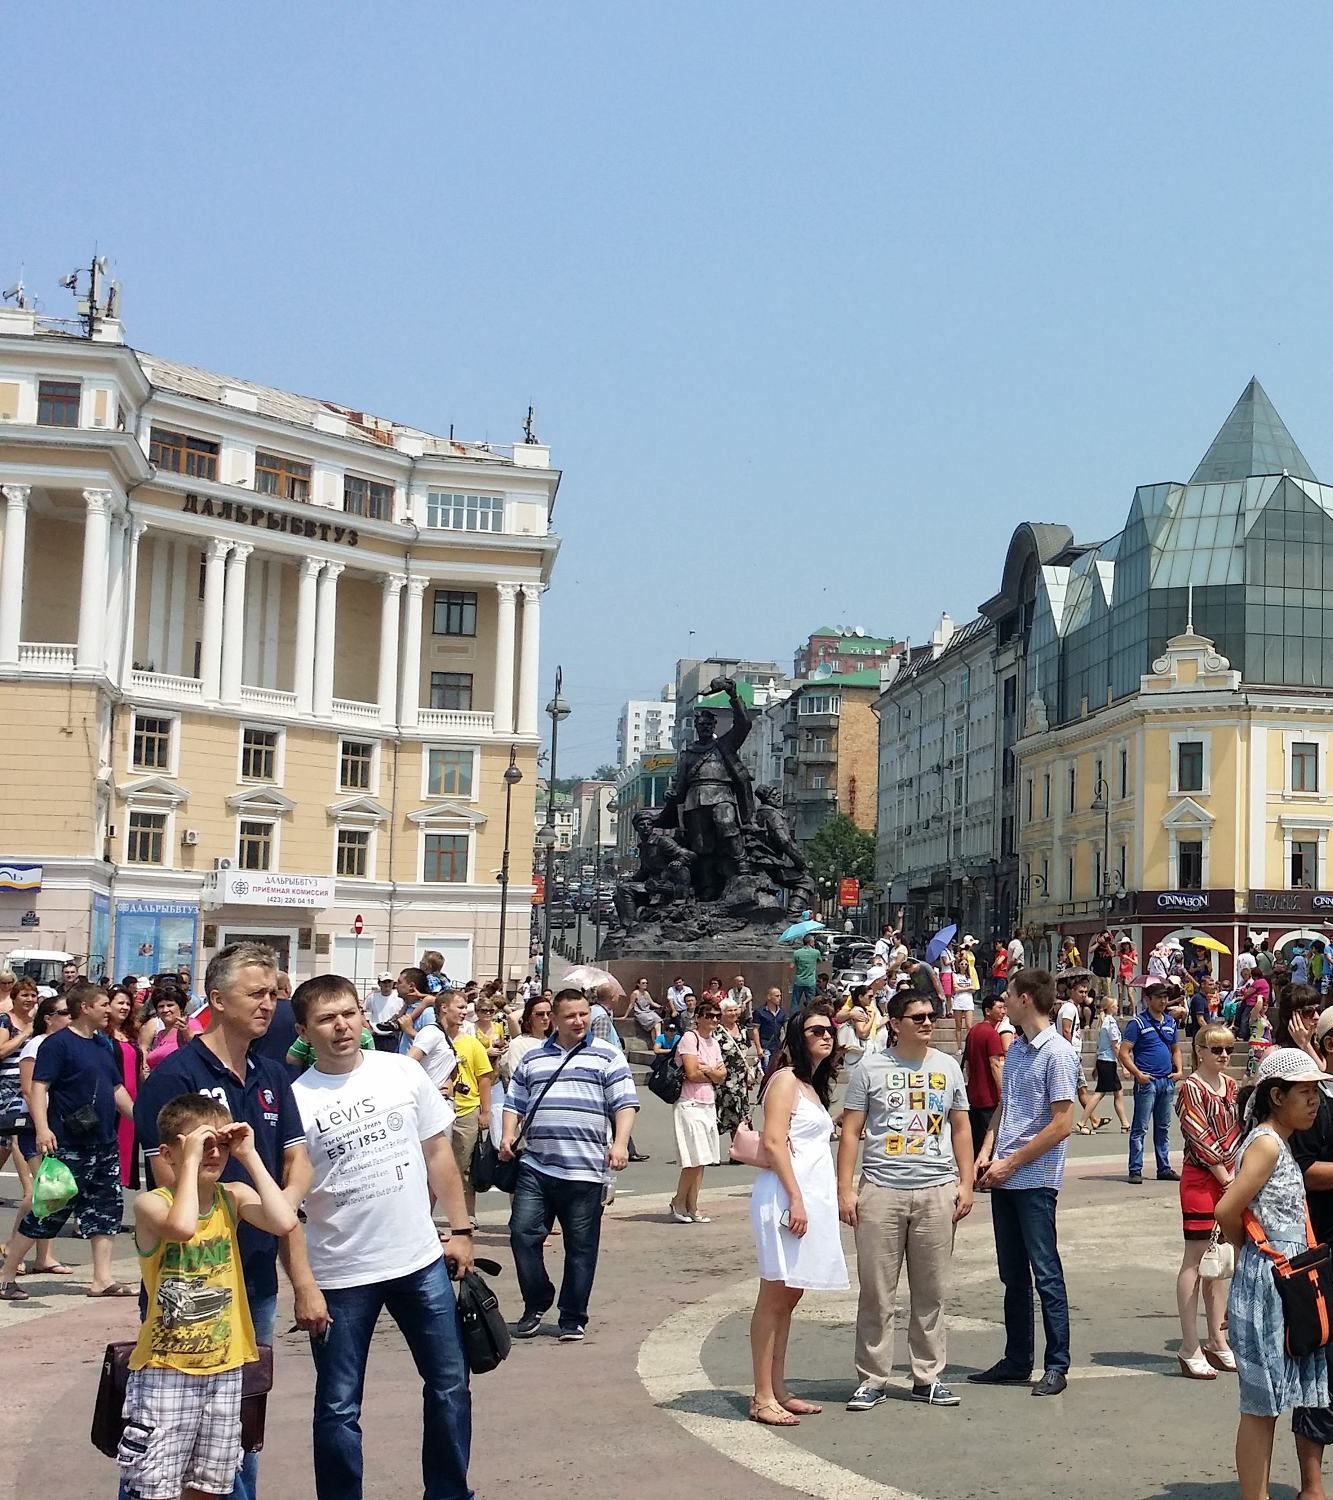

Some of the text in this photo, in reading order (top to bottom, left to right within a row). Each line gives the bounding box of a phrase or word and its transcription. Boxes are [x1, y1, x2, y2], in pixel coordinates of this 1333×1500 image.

[182, 494, 359, 546] ДАЛЬРЫБВТУЗ
[292, 888, 329, 897] КОМИССИЯ
[266, 896, 284, 904] (423)
[1158, 893, 1208, 906] CINNABON
[130, 904, 199, 914] ДАЛЬРЫБВТУЗ
[326, 1140, 356, 1160] EST.
[359, 1128, 388, 1148] 1853
